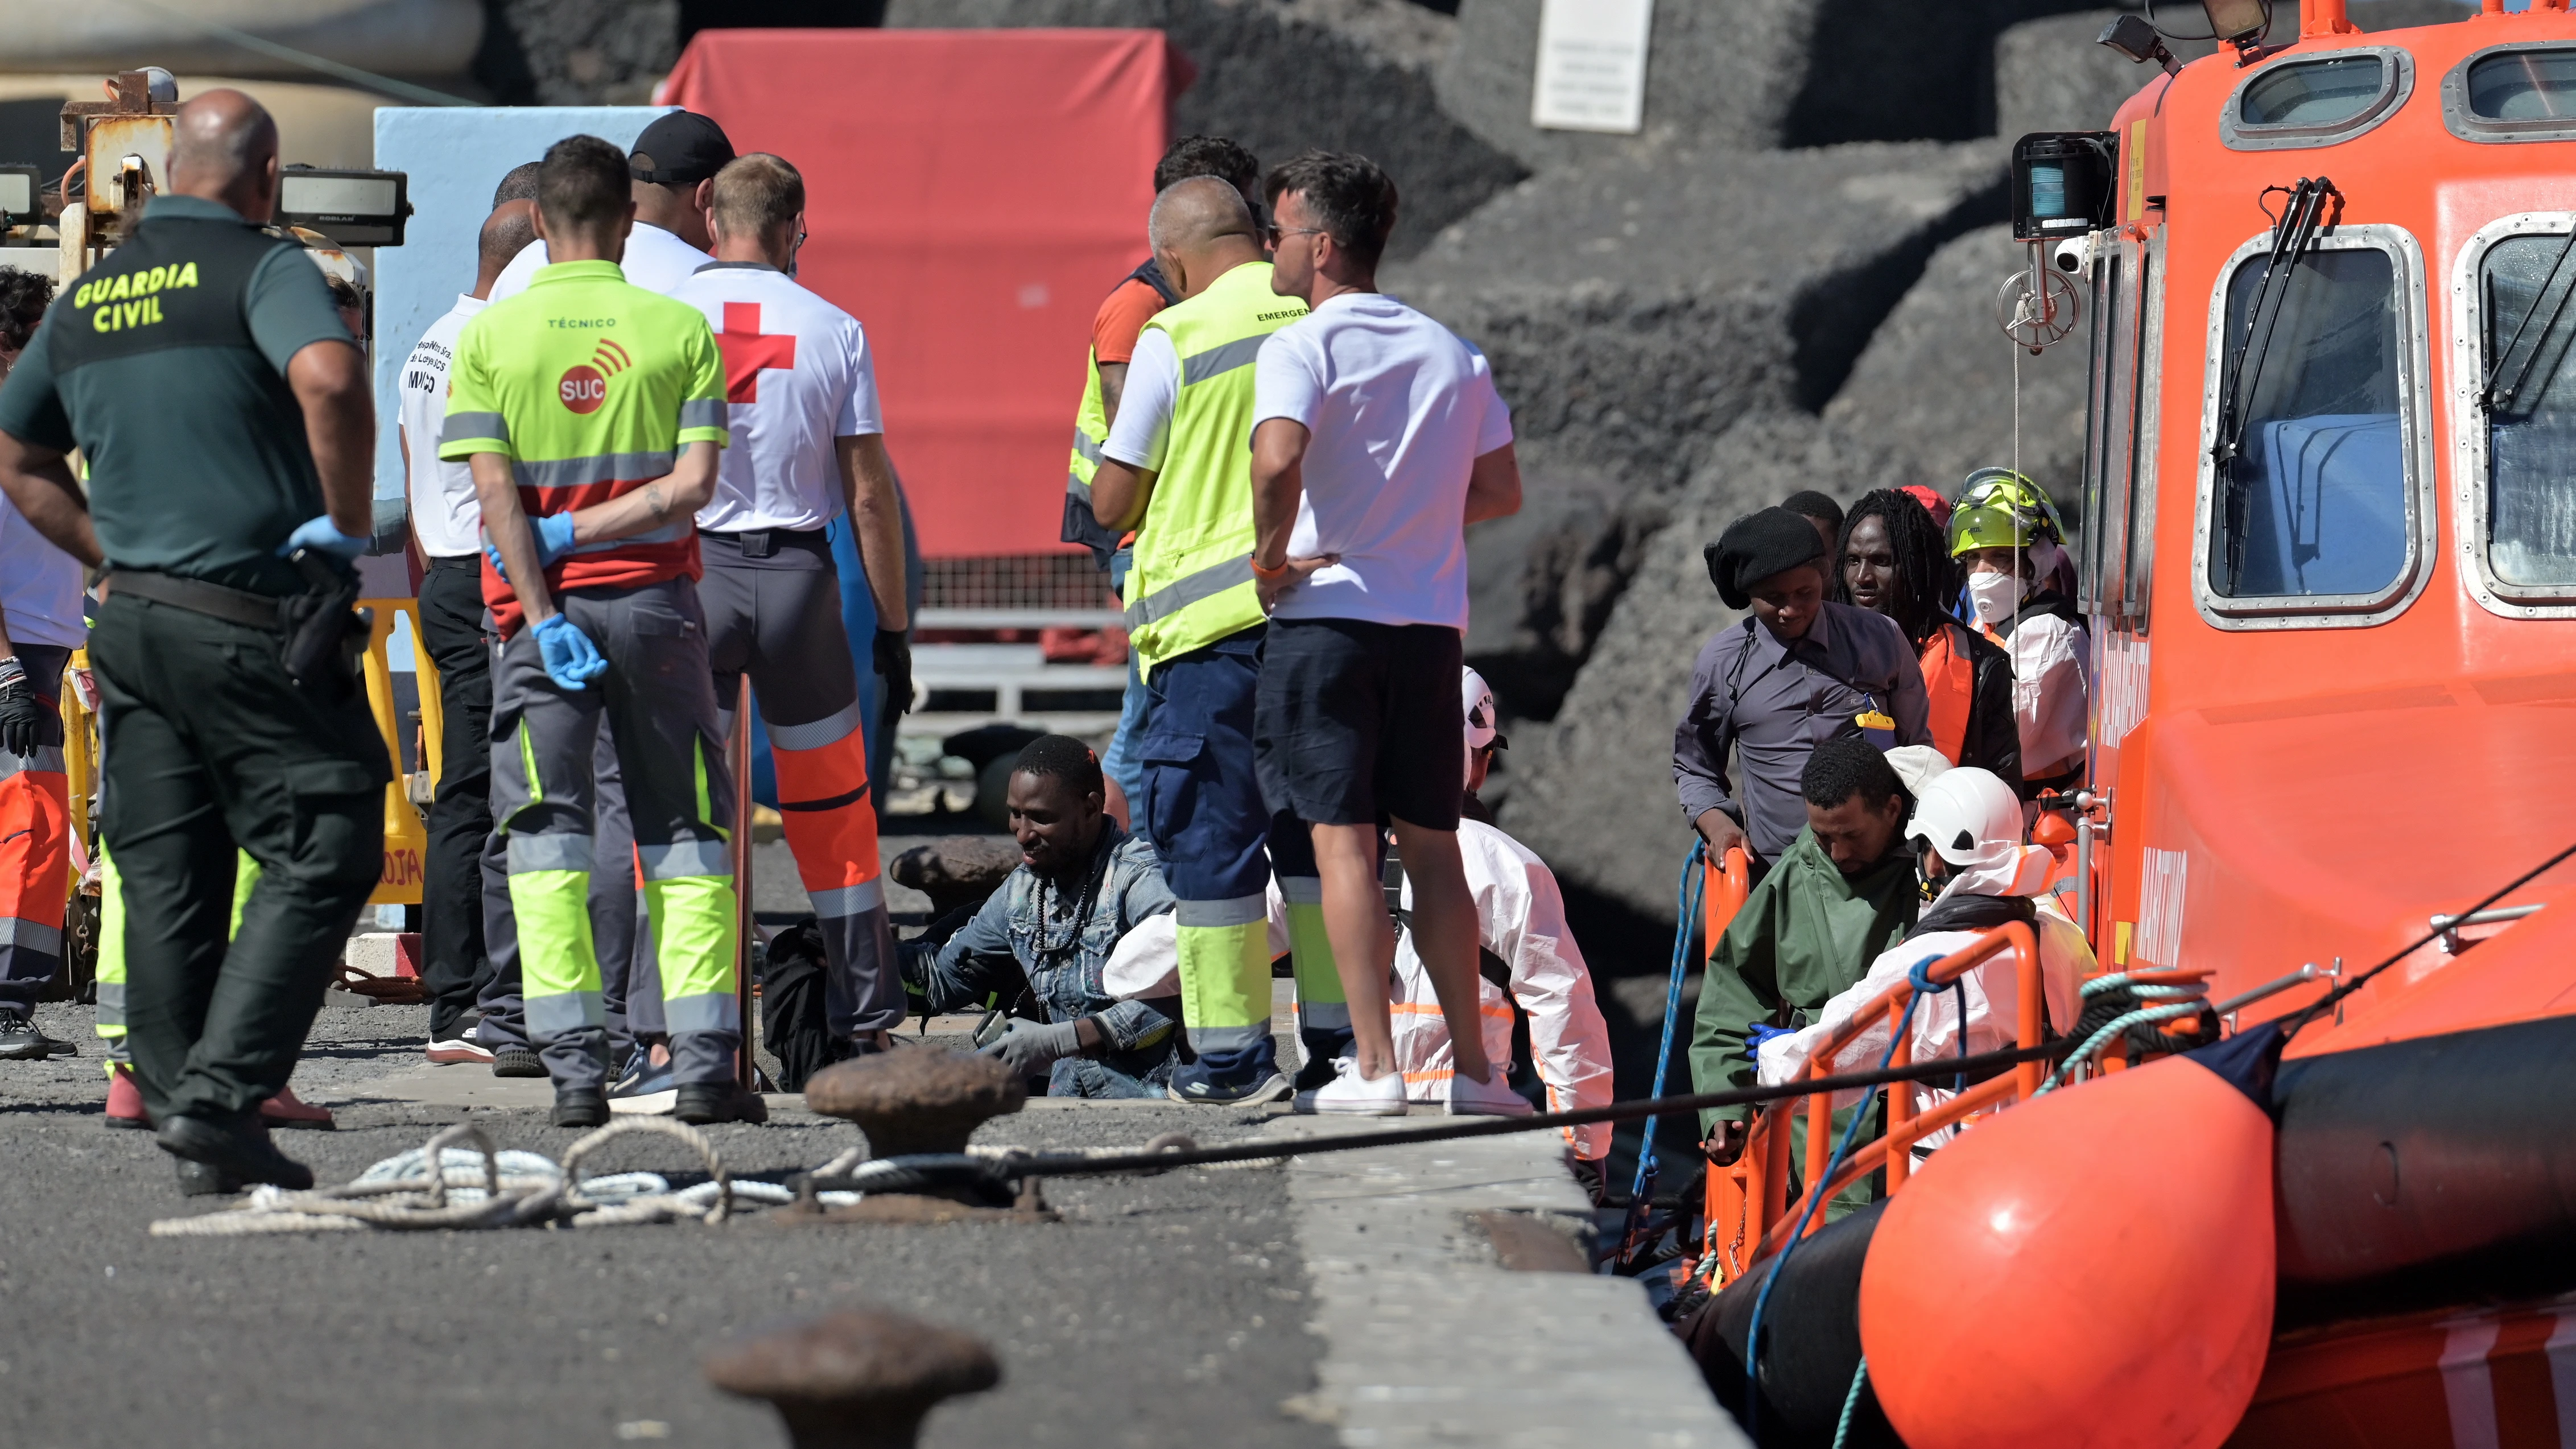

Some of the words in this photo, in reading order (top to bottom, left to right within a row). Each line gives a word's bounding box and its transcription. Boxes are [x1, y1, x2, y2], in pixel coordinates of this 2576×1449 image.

[75, 262, 198, 309] GUARDIA
[93, 295, 163, 333] CIVIL
[548, 316, 616, 328] TÉCNICO
[440, 346, 452, 360] Sra.
[560, 378, 604, 401] SUC
